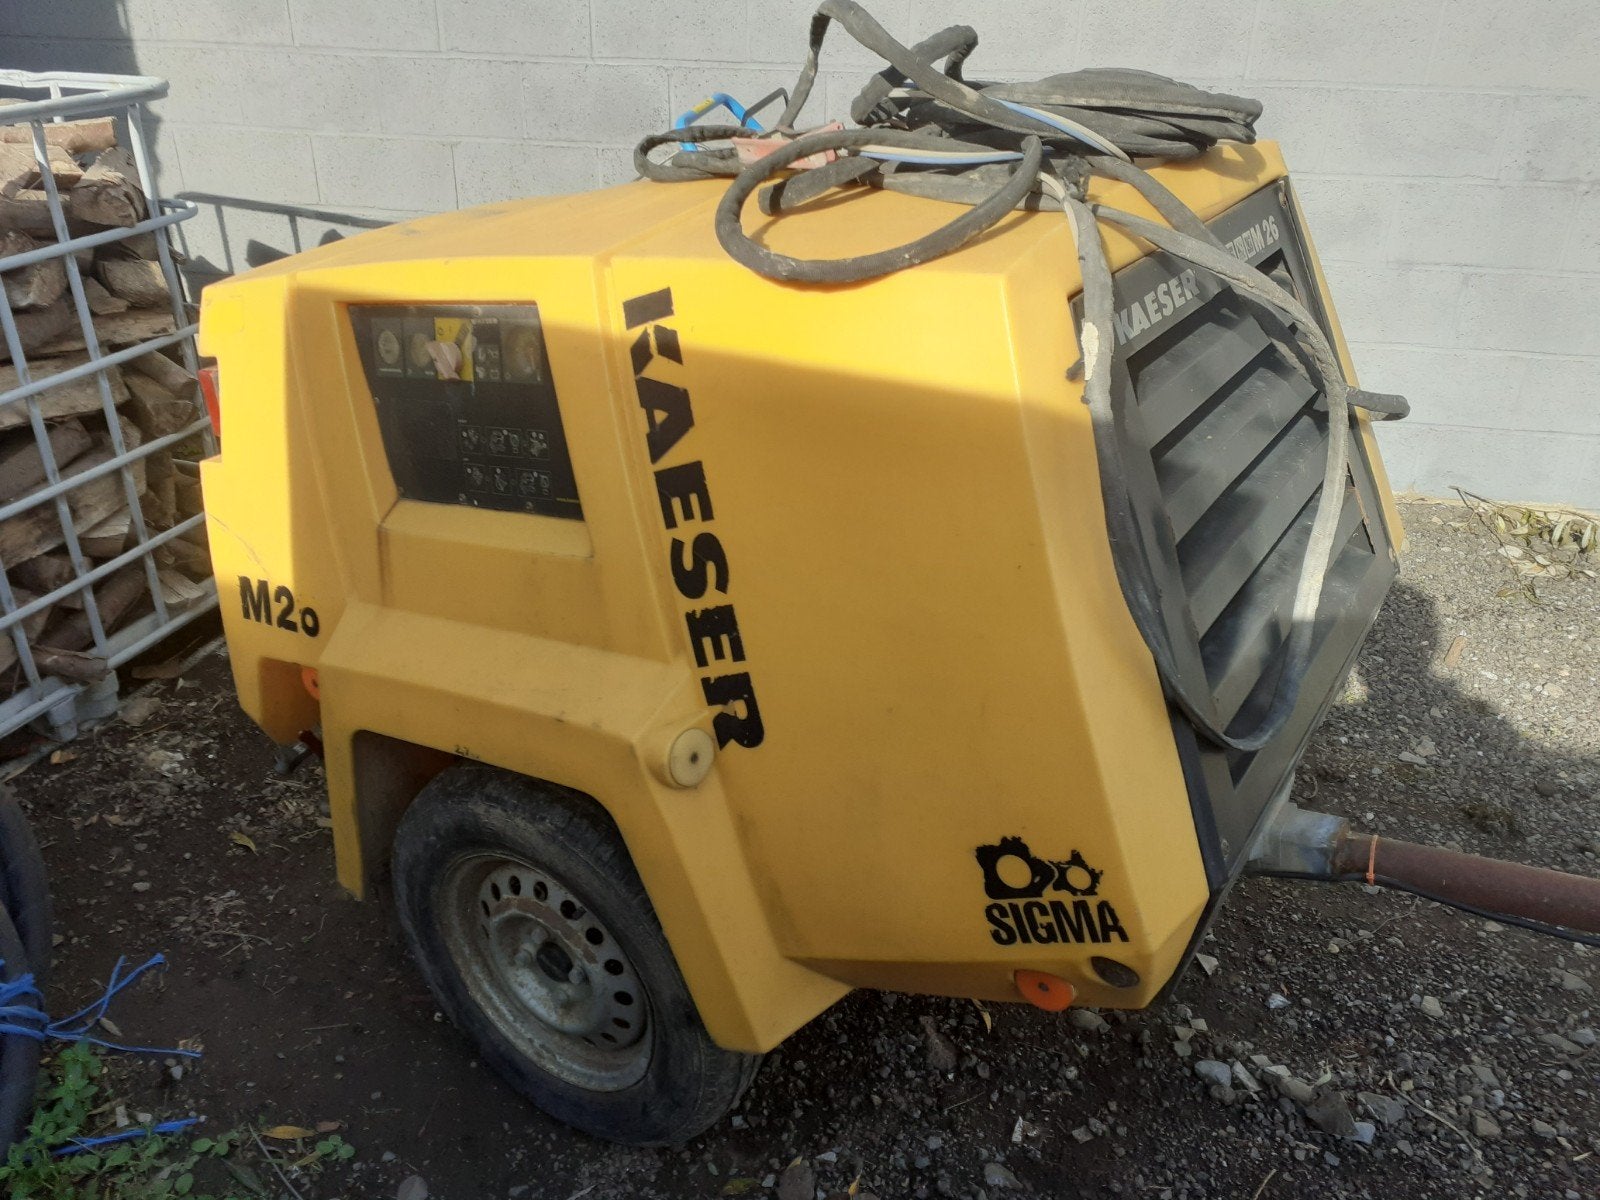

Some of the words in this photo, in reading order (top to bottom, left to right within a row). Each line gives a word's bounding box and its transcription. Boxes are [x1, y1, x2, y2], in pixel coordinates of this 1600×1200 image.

[1115, 268, 1200, 346] KAESER
[622, 286, 765, 751] KAESER
[985, 899, 1130, 946] SIGMA
